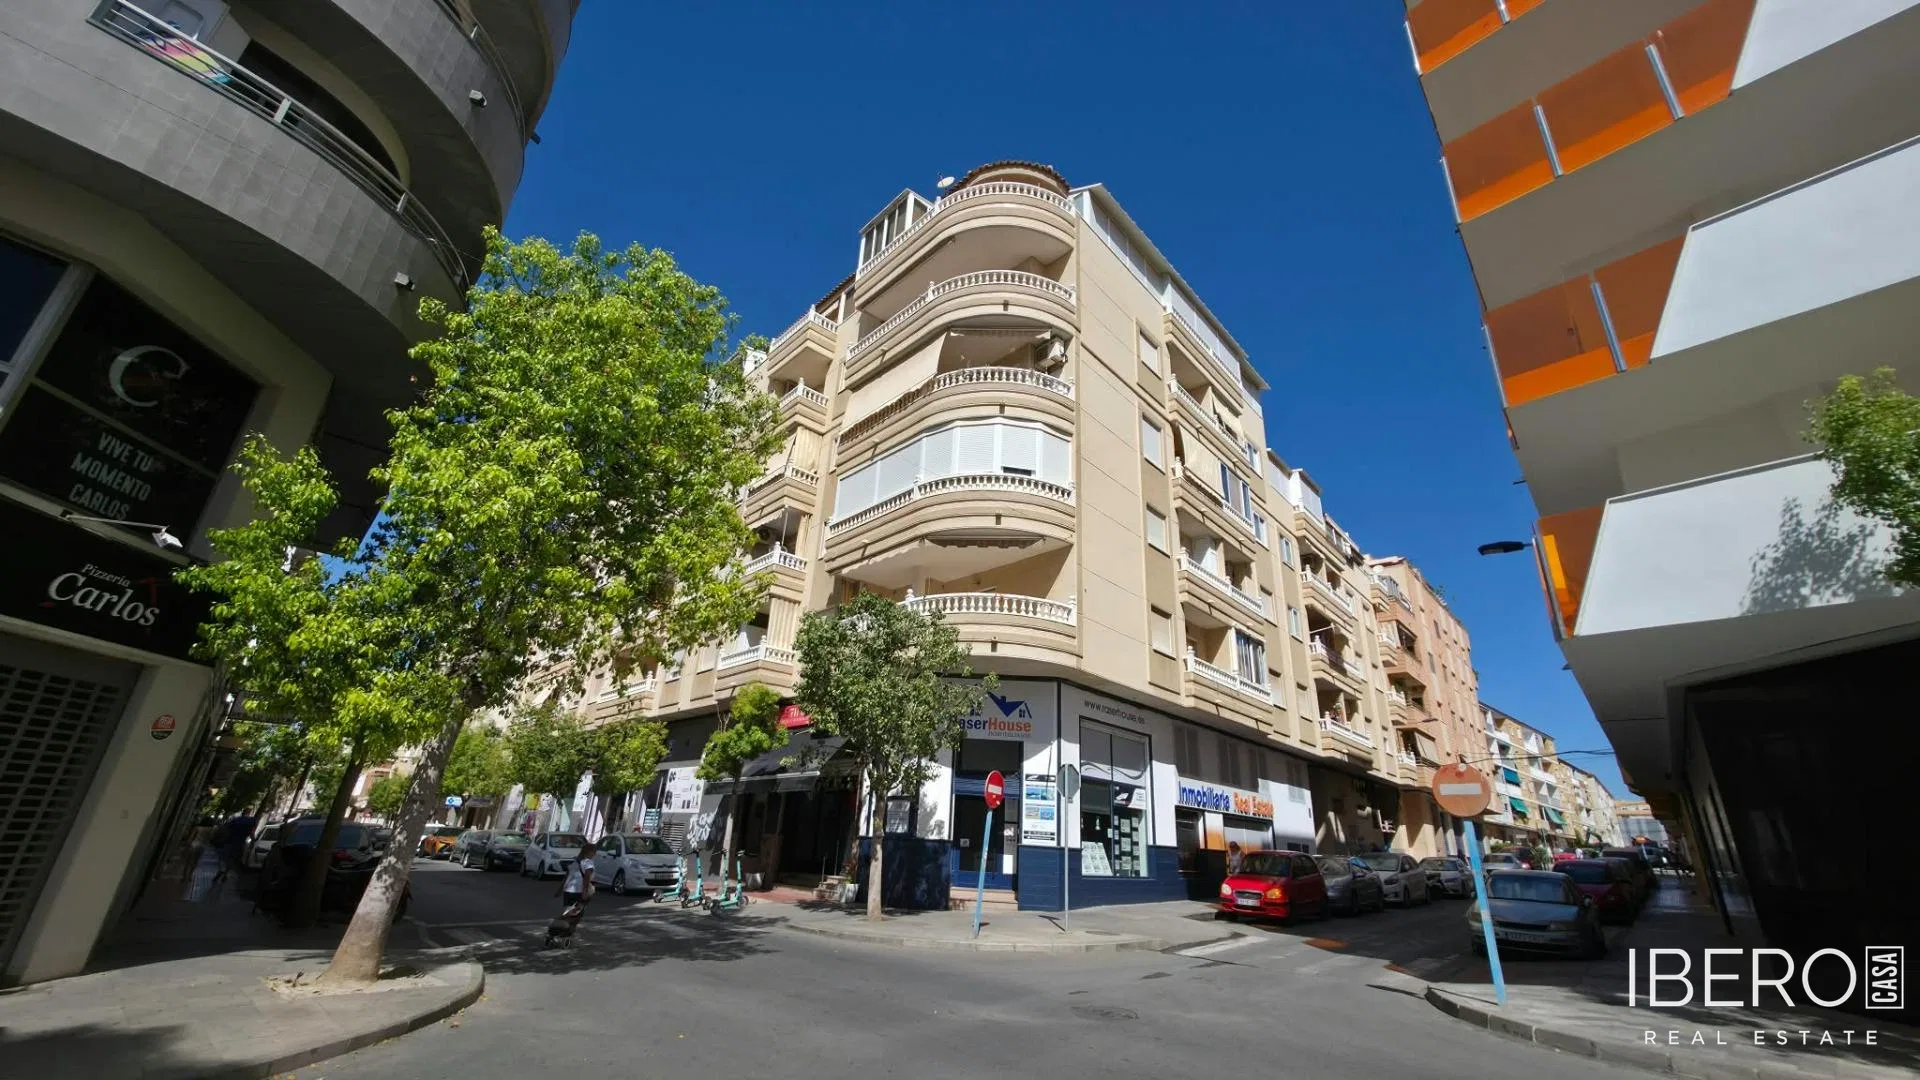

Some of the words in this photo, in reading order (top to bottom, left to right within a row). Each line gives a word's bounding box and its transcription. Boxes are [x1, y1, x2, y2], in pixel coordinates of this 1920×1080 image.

[109, 345, 190, 407] C
[98, 432, 134, 463] VIVE
[132, 449, 154, 472] TU
[70, 451, 151, 501] MOMENTO
[69, 483, 130, 521] CARLOS
[82, 563, 132, 587] Pizzeria
[48, 572, 160, 626] Carlos
[958, 716, 1032, 733] aserHouse
[1178, 780, 1230, 811] Inmobiliaria
[1233, 791, 1251, 814] Real
